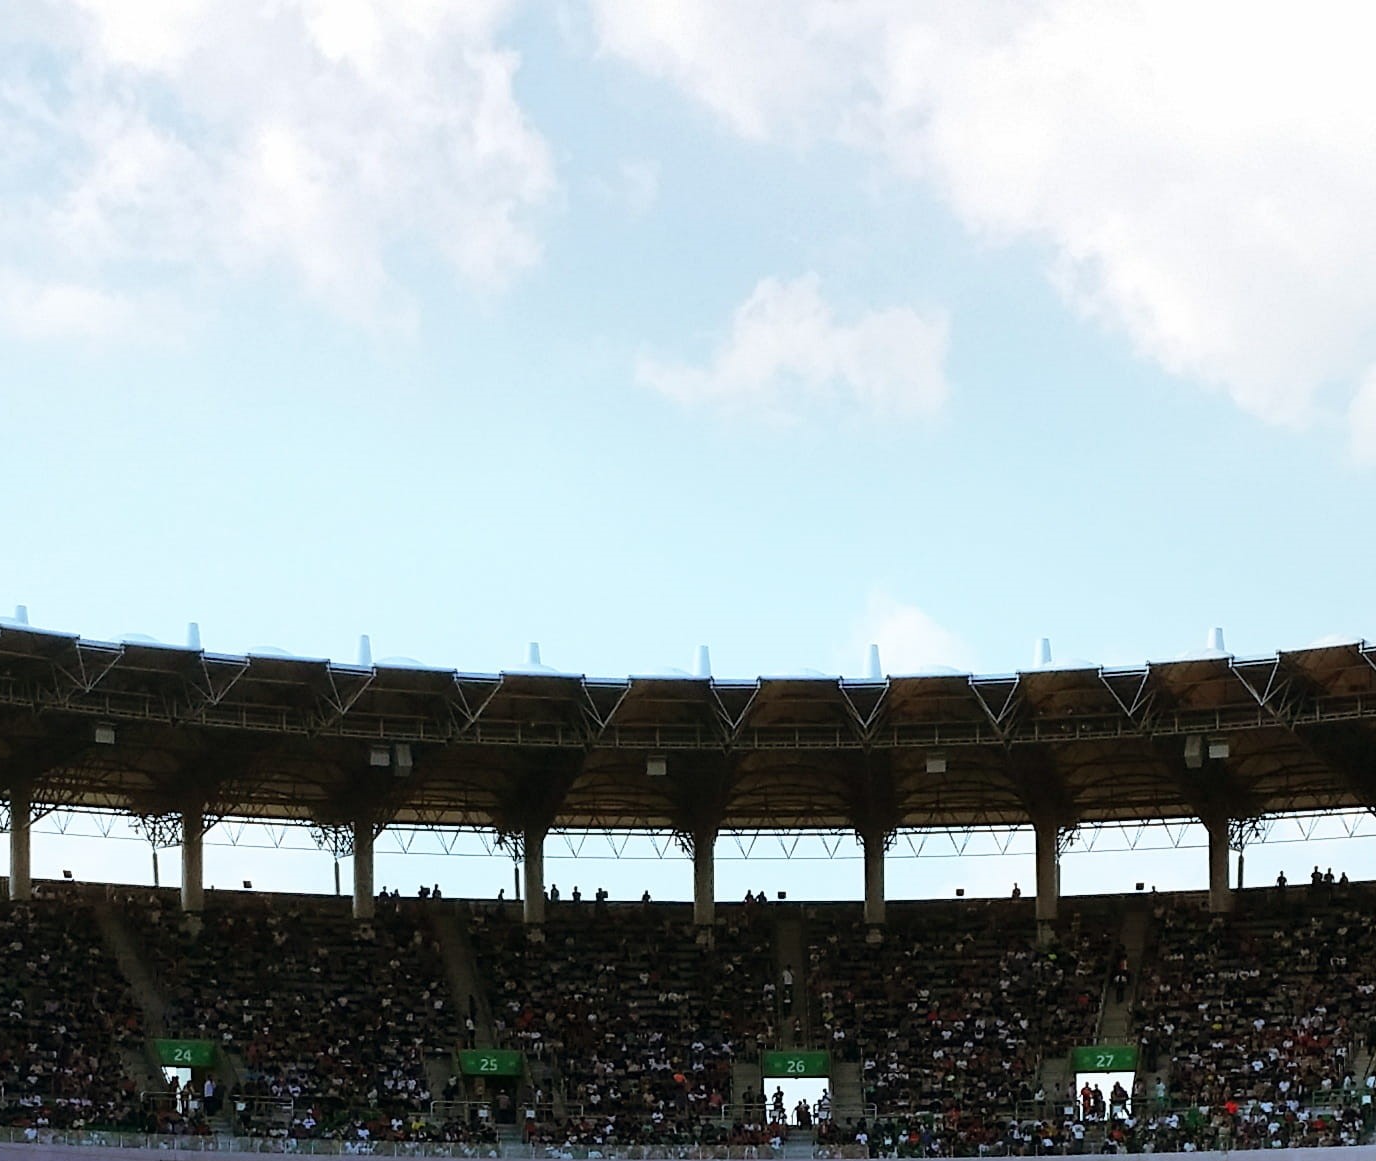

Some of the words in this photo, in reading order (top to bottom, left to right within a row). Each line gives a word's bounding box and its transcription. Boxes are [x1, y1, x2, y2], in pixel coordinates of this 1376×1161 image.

[174, 1049, 192, 1064] 24
[1096, 1054, 1113, 1069] 27
[480, 1058, 498, 1072] 25
[787, 1059, 805, 1074] 26
